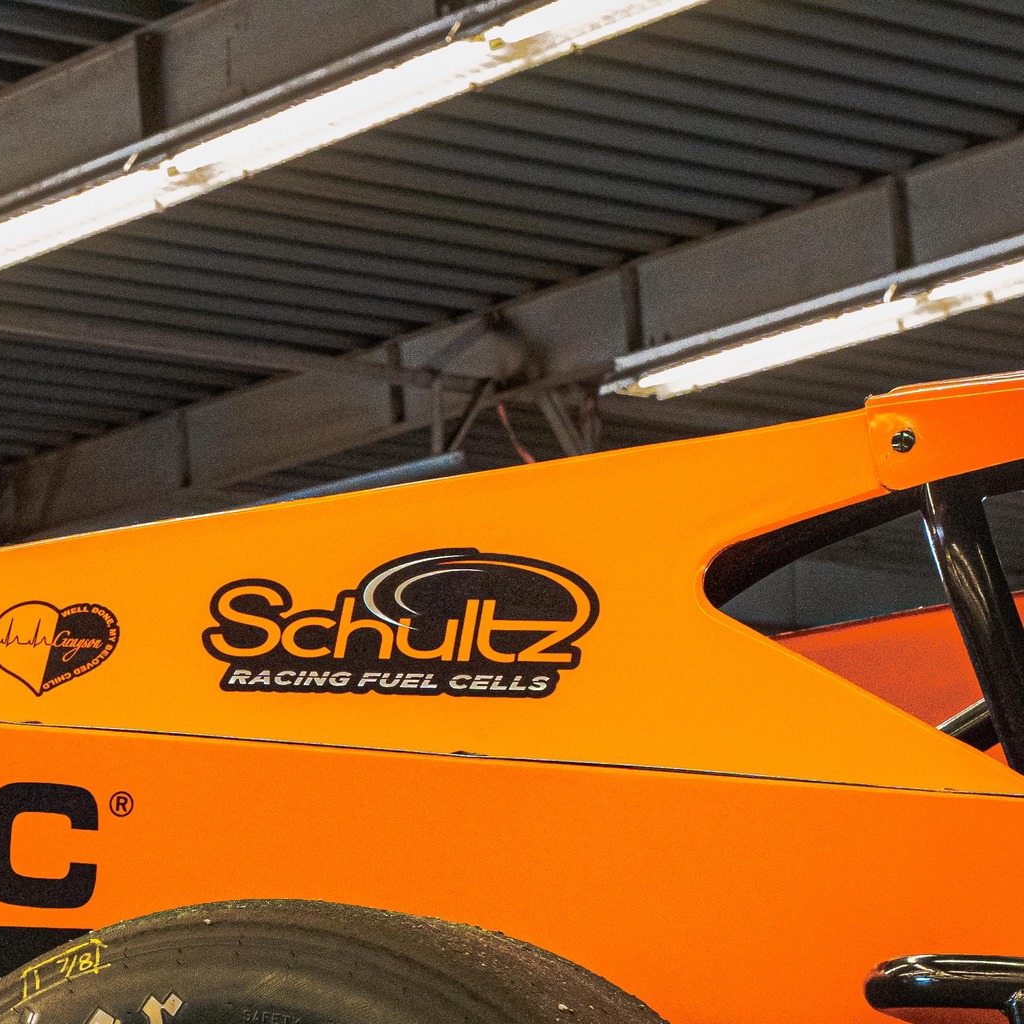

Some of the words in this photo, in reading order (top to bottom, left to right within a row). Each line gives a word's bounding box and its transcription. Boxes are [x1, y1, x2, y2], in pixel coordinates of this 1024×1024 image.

[61, 606, 89, 618] WELL
[210, 575, 591, 663] Schultz
[52, 630, 103, 662] Grayson
[108, 628, 117, 642] MY
[73, 644, 113, 675] BELOVED
[42, 673, 72, 690] CHILD
[228, 669, 352, 687] RACING
[357, 671, 439, 689] FUEL
[449, 674, 551, 692] CELLS
